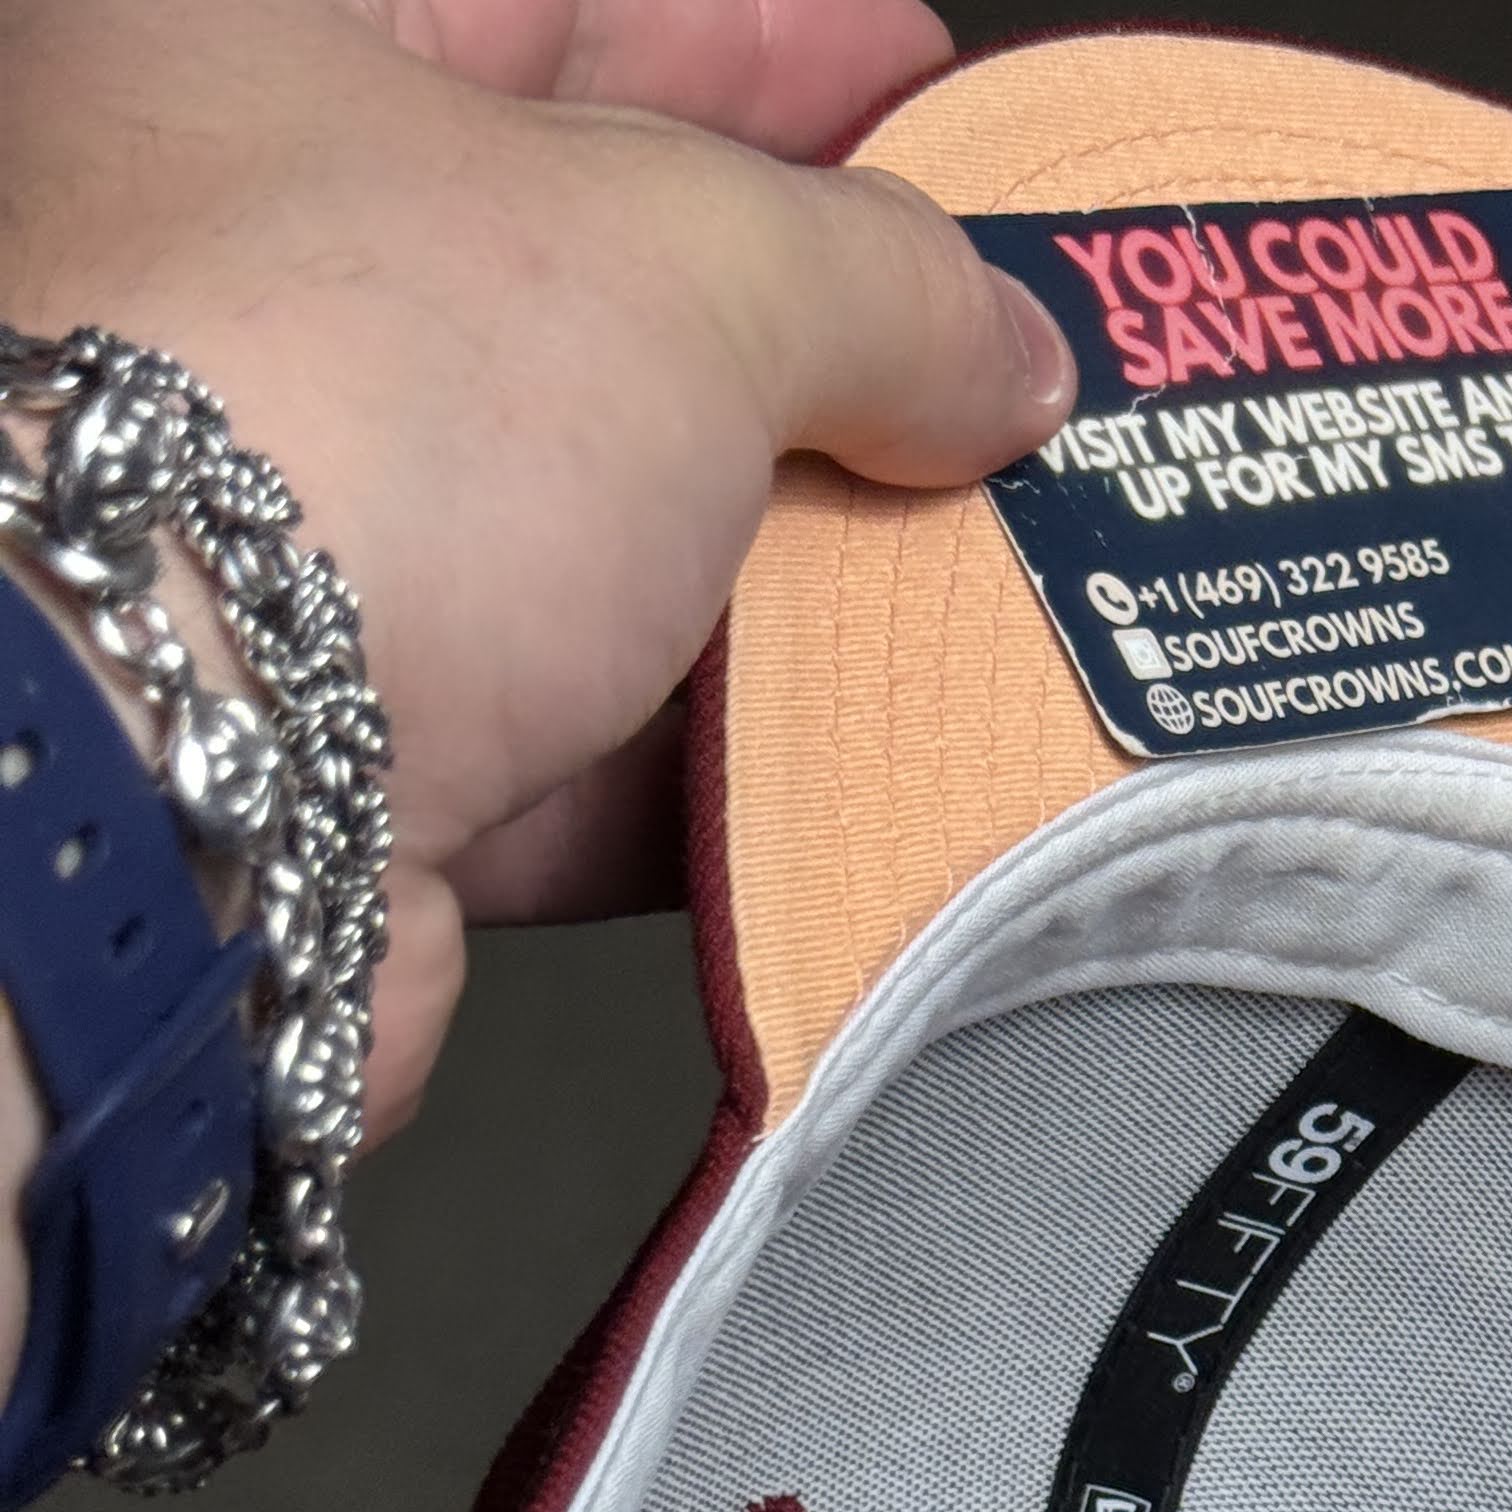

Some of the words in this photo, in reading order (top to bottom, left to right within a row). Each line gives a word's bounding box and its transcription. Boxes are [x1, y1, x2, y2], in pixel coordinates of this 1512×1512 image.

[1053, 223, 1247, 310] YOU
[1249, 210, 1494, 294] COULD
[1106, 294, 1323, 387] SAVE
[1039, 414, 1155, 473] VISIT
[1157, 402, 1243, 460] MY
[1243, 380, 1460, 447] WEBSITE
[1118, 465, 1191, 520] UP
[1195, 450, 1316, 511] FOR
[1307, 439, 1389, 495] MY
[1396, 425, 1504, 484] SMS
[1139, 577, 1179, 613] +1
[1177, 561, 1282, 620] (469)
[1278, 556, 1360, 596] 322
[1357, 537, 1450, 584] 9585
[1164, 601, 1425, 672] SOUFCROWNS
